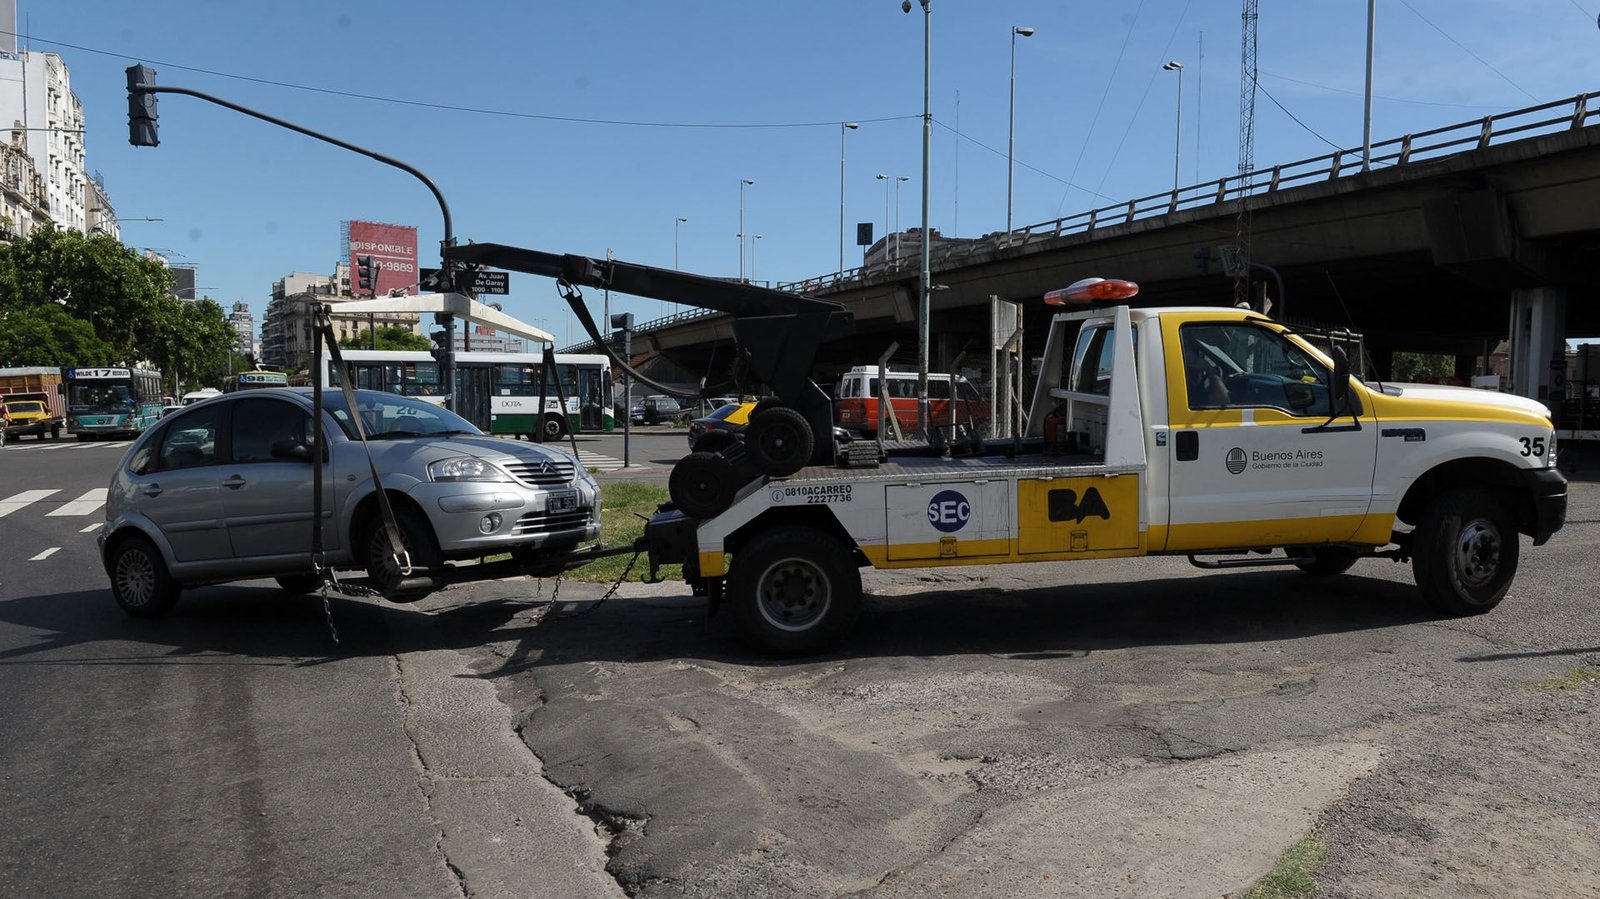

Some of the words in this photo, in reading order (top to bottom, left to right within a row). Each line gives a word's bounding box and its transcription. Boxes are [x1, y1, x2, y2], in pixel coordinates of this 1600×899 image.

[354, 242, 413, 254] DISPONIBLE
[355, 260, 413, 272] 3-9889
[93, 369, 112, 377] 17
[1518, 437, 1545, 457] 35
[1252, 450, 1293, 461] Buenos
[1295, 449, 1323, 459] Aires
[1252, 462, 1281, 470] Gobierno
[1300, 460, 1323, 468] Ciudad
[785, 485, 852, 496] 0810ACARREO
[807, 494, 852, 503] 2227736
[1048, 486, 1111, 524] BA
[928, 500, 970, 523] SEC
